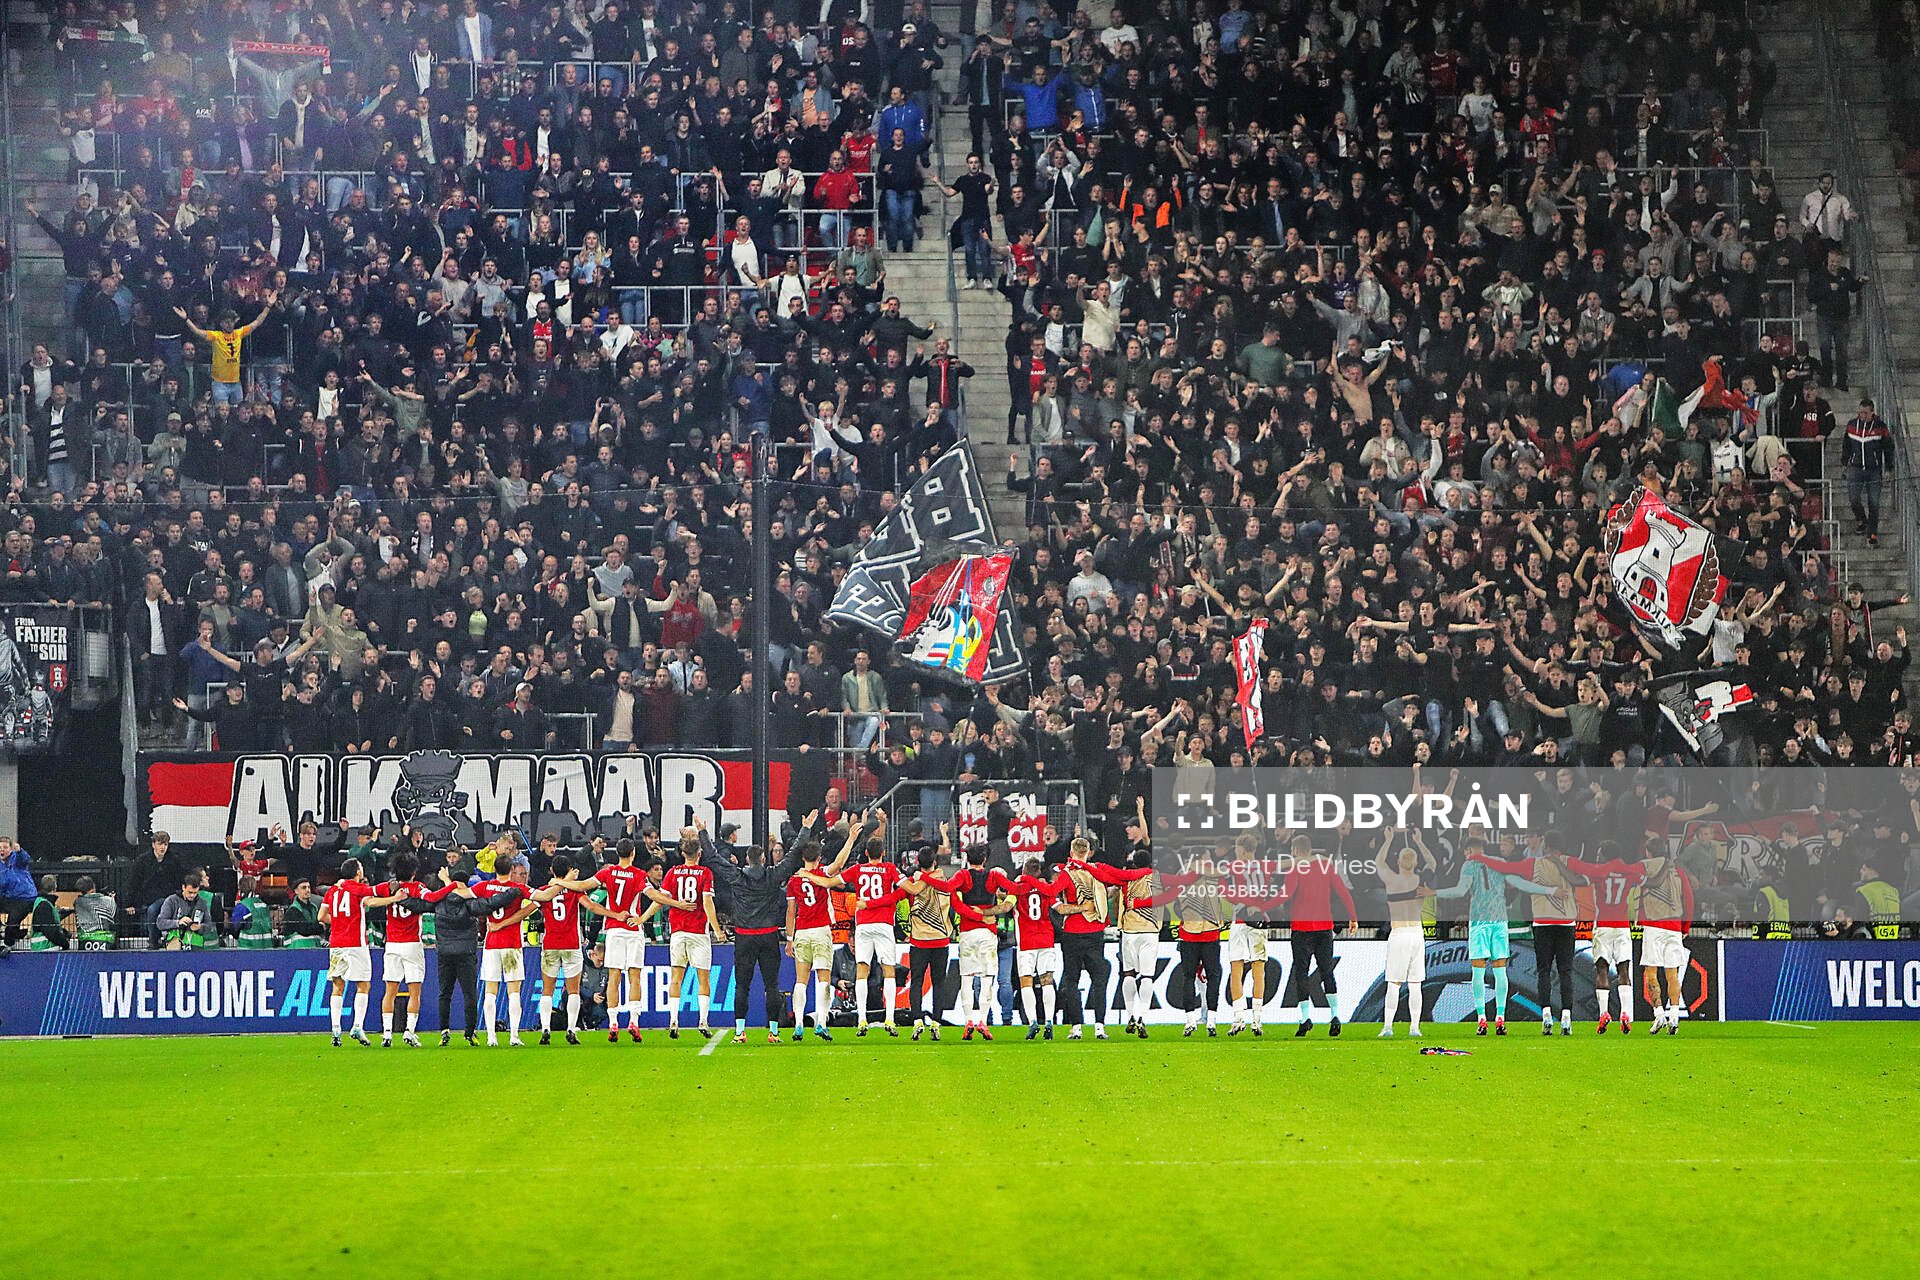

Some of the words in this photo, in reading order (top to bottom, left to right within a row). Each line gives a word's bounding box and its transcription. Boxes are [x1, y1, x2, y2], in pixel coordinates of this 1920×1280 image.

[15, 626, 67, 643] FATHER
[30, 643, 39, 652] TO
[39, 643, 68, 661] SON
[226, 755, 722, 846] ALKMAAR
[615, 879, 626, 906] 7
[677, 876, 697, 904] 18
[801, 882, 817, 906] 3
[859, 874, 883, 901] 28
[1604, 878, 1627, 904] 17
[332, 890, 351, 917] 14
[552, 890, 566, 921] 5
[1028, 893, 1041, 920] 8
[85, 942, 106, 950] 004
[98, 970, 275, 1019] WELCOME
[1826, 960, 1920, 1009] WELC
